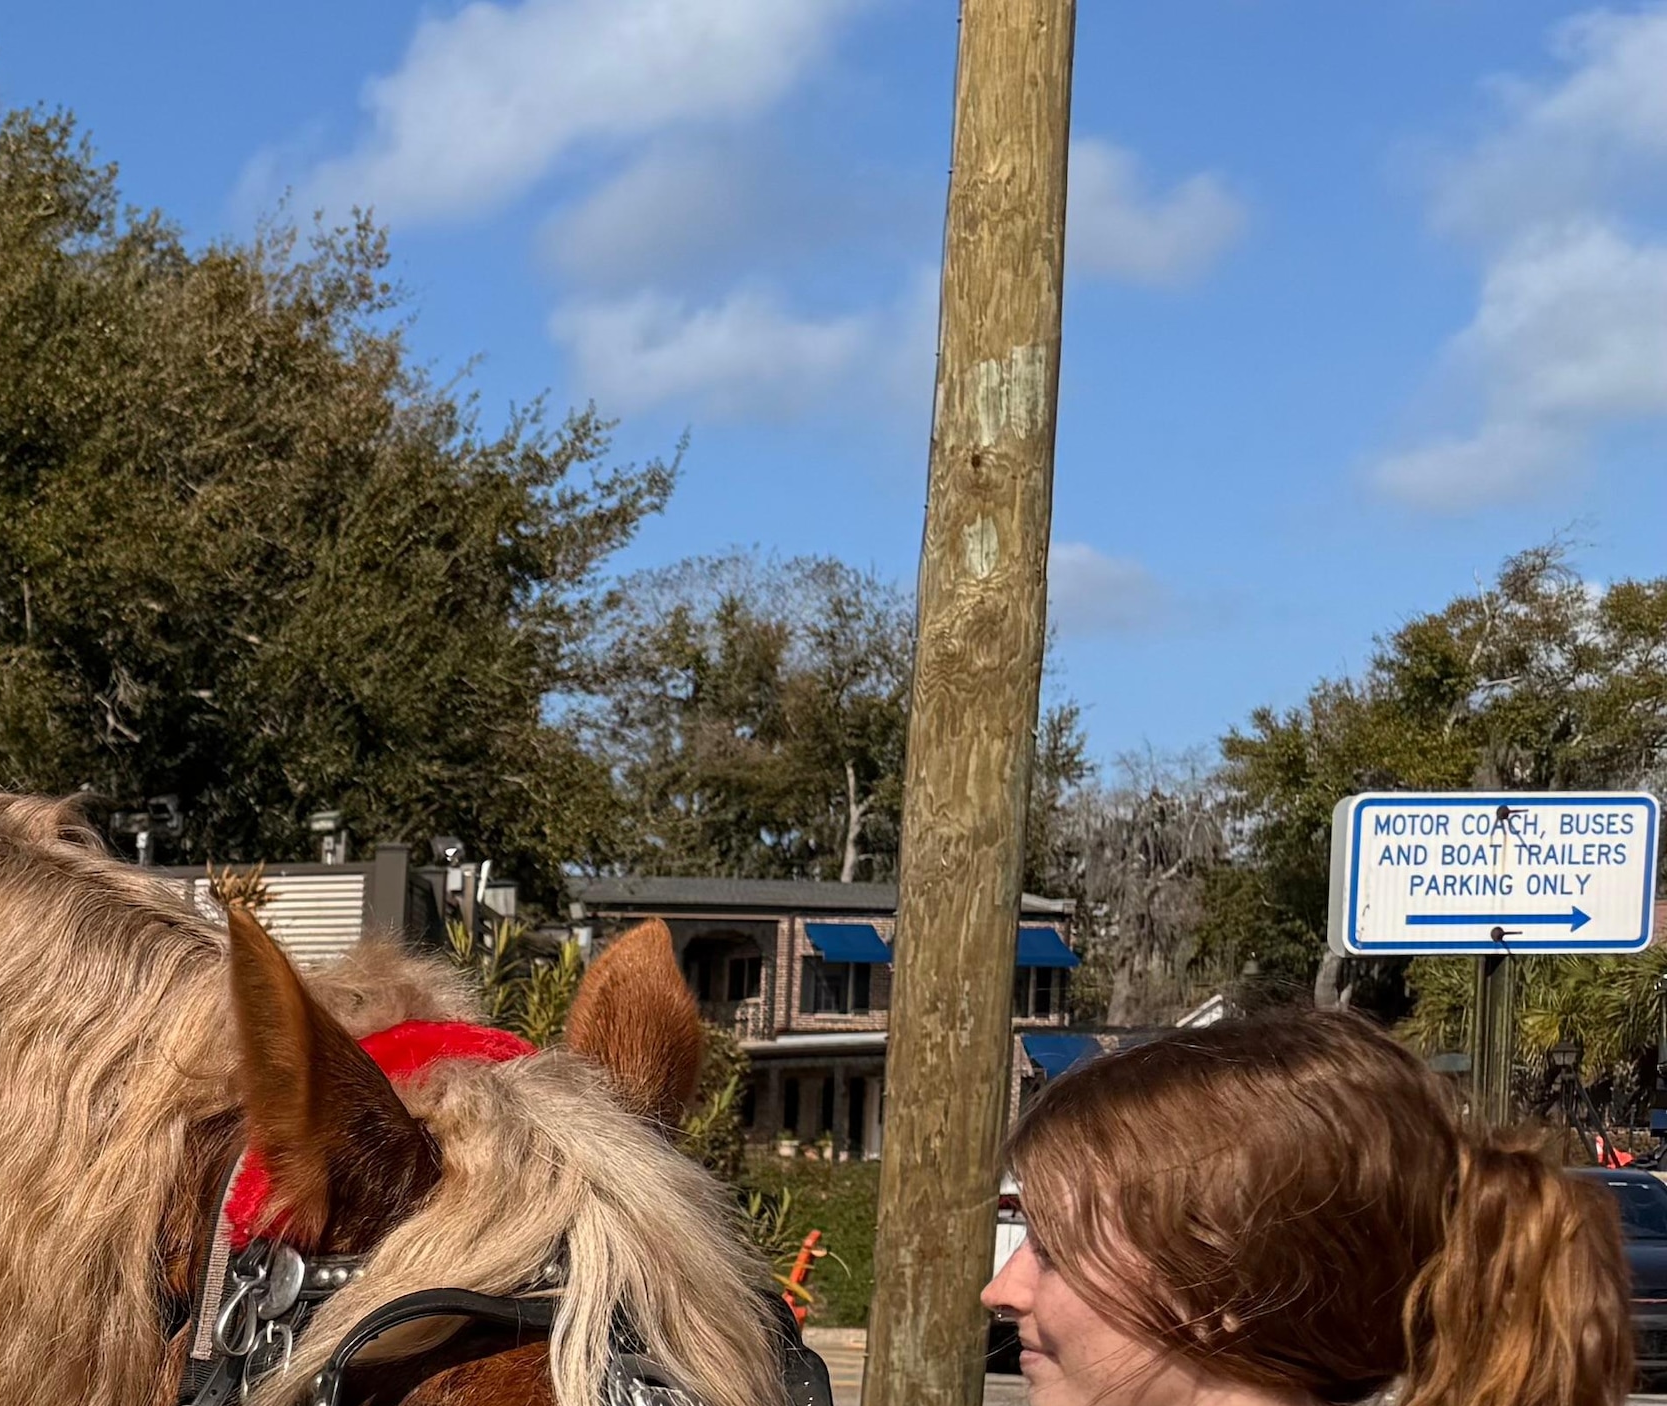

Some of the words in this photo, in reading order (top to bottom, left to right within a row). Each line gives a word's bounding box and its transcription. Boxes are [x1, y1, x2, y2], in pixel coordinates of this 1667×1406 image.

[1374, 814, 1449, 836] MOTOR
[1462, 814, 1546, 839] COACH,
[1560, 814, 1634, 835] BUSES
[1378, 845, 1427, 866] AND
[1441, 845, 1502, 866] BOAT
[1514, 844, 1627, 866] TRAILERS
[1409, 875, 1513, 896] PARKING
[1527, 874, 1591, 895] ONLY
